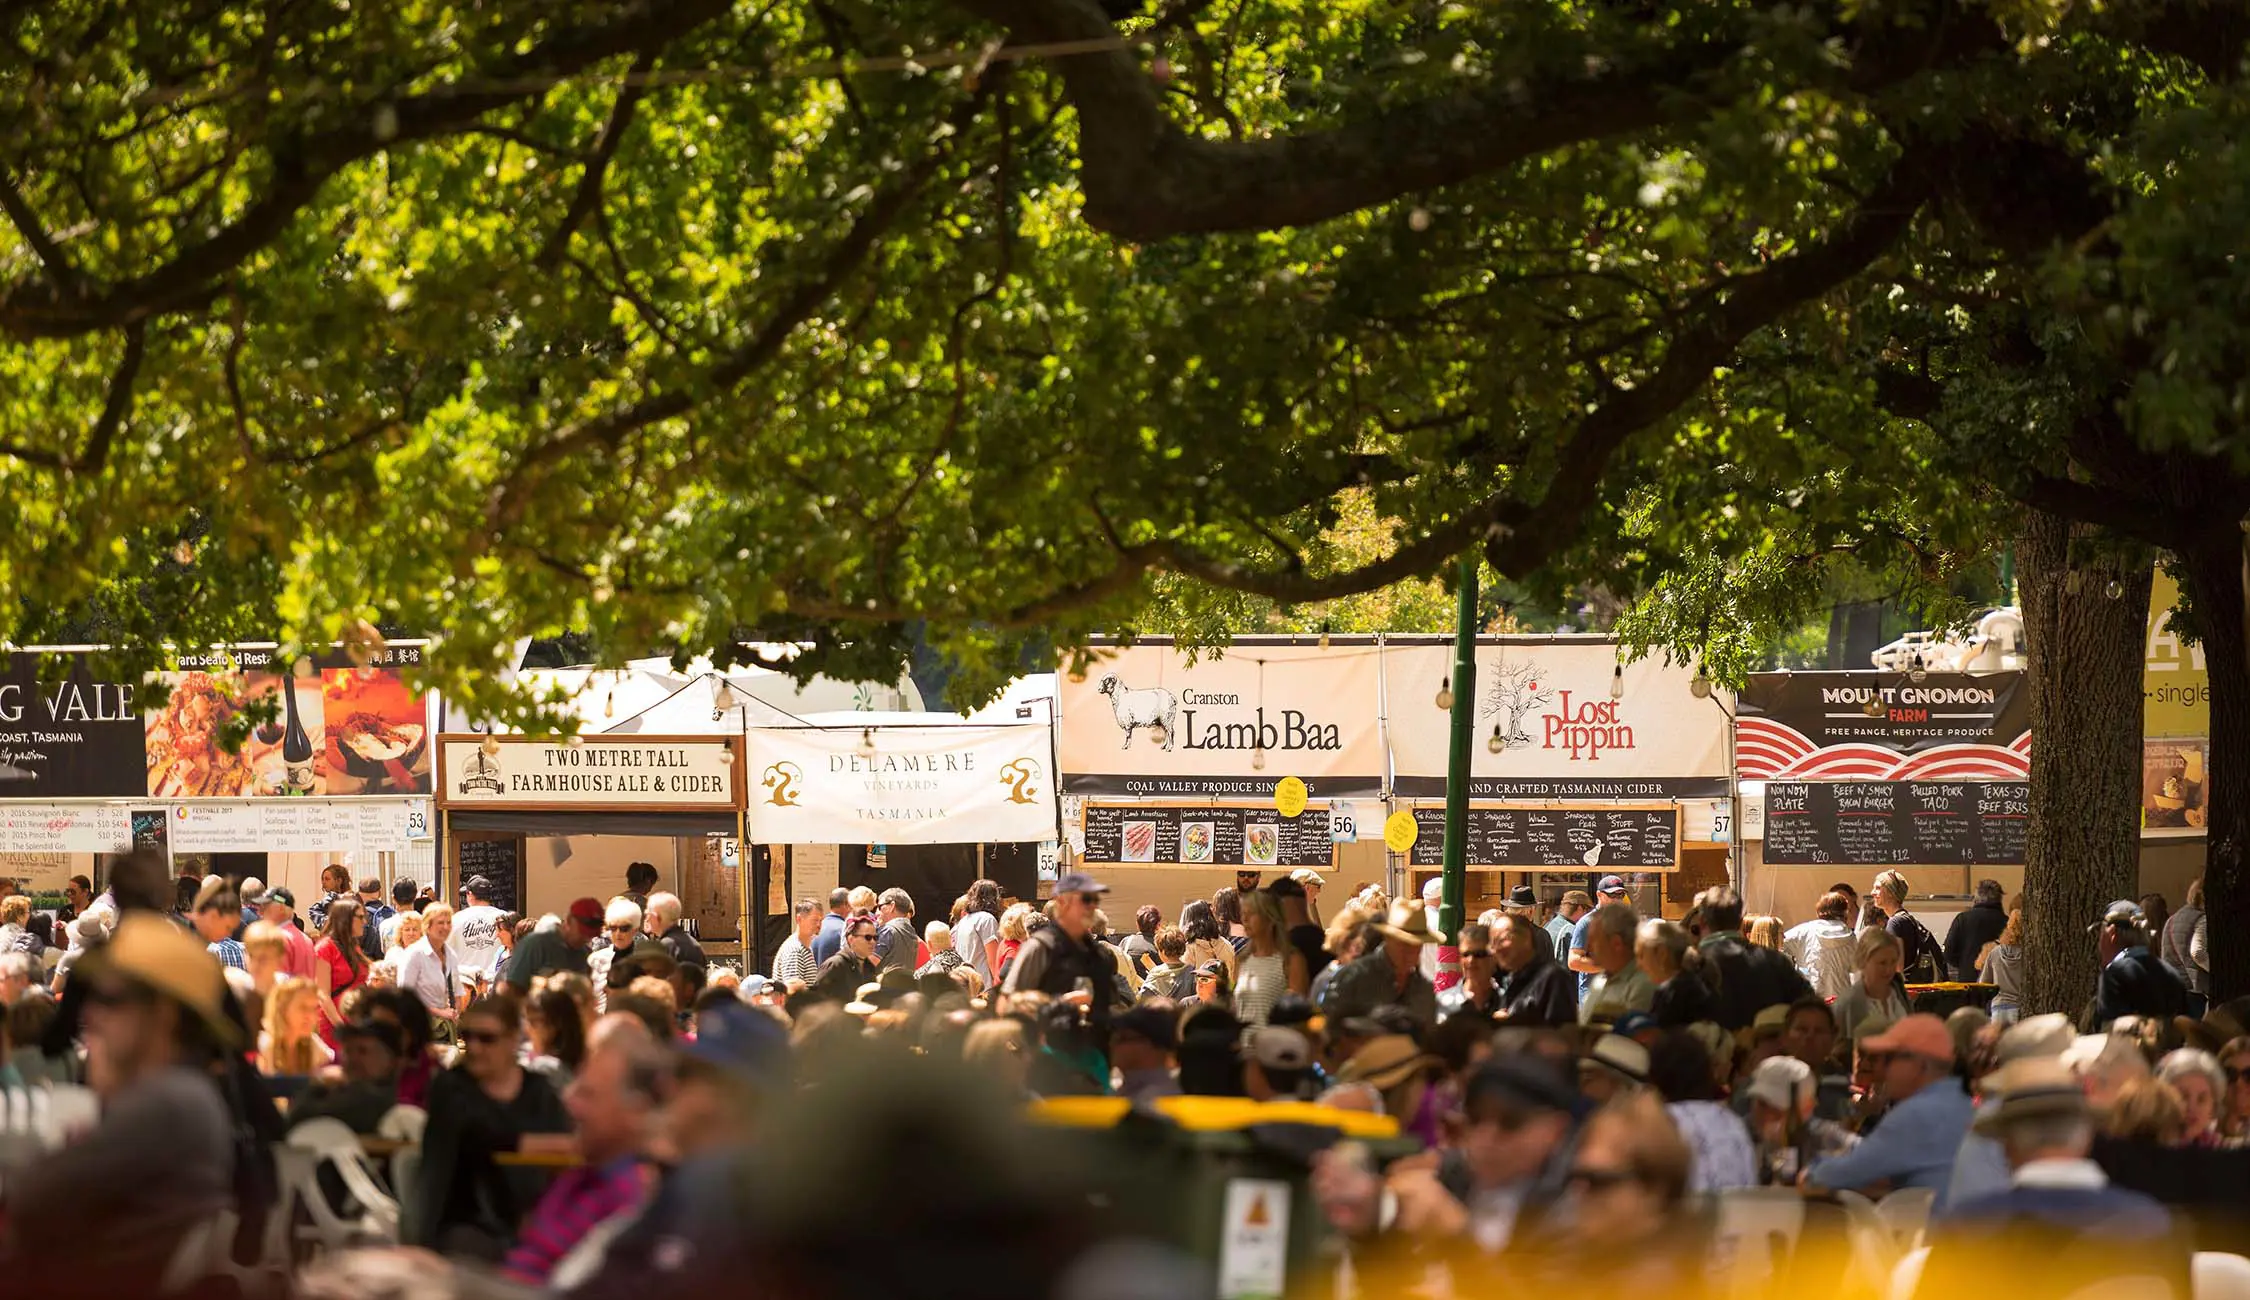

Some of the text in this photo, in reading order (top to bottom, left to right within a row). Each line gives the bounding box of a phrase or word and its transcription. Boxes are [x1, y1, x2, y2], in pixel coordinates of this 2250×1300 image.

[1182, 688, 1239, 705] Cranston
[1822, 688, 1994, 704] MOUNT GNOMON
[2157, 682, 2210, 706] single
[36, 681, 136, 723] VALE
[1559, 690, 1621, 725] Lost
[1889, 709, 1928, 722] FARM
[1182, 707, 1342, 750] Lamb Baa
[1825, 728, 1994, 737] FREE RANGE, HERITAGE PRODUCE
[32, 732, 84, 742] TASMANIA
[1541, 714, 1635, 760] Pippin
[545, 749, 689, 767] TWO METRE TALL
[829, 752, 975, 773] DELAMERE
[512, 774, 613, 792] FARMHOUSE
[617, 775, 649, 792] ALE
[653, 776, 666, 792] &
[671, 775, 724, 793] CIDER
[863, 780, 939, 791] VINEYARDS
[1126, 781, 1155, 792] COAL
[1159, 781, 1199, 792] VALLEY
[1202, 782, 1253, 792] PRODUCE
[1467, 783, 1664, 794] AND CRAFTED TASMANIAN CIDER
[1832, 784, 1854, 798] BEEF
[1910, 784, 1964, 798] PULLED PORK
[1770, 784, 1809, 799] NOM NOM
[1980, 784, 2030, 799] TEXAS-STY
[1774, 797, 1805, 811] PLATE
[1864, 797, 1895, 811] BURGER
[1921, 797, 1949, 812] TACO
[1976, 800, 2029, 815] BEEF BRIS
[409, 813, 424, 829] 53
[856, 807, 948, 820] TASMANIA
[1334, 816, 1353, 833] 56
[1714, 816, 1730, 832] 57
[1812, 850, 1830, 863] $20
[1892, 848, 1910, 861] $12
[1041, 854, 1055, 871] 55
